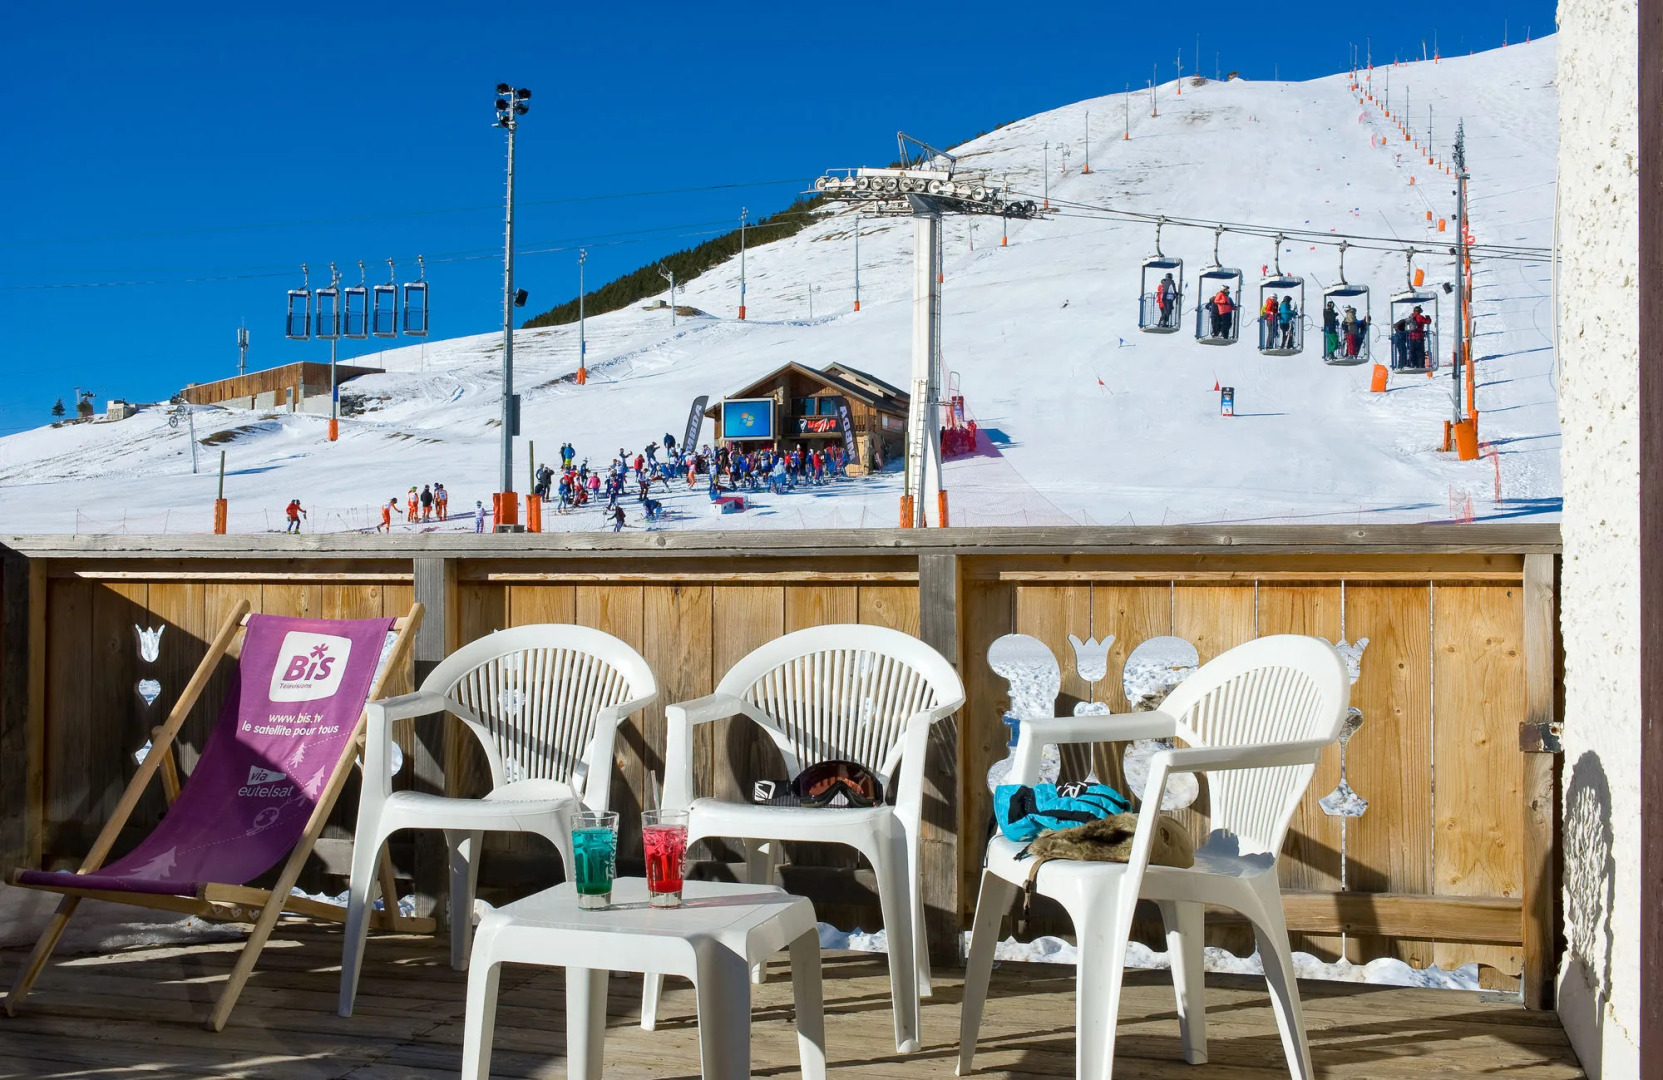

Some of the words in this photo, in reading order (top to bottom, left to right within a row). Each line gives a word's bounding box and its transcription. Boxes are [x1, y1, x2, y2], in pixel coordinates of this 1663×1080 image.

[839, 405, 856, 461] MBDA
[268, 712, 324, 724] www.bis.tv
[241, 720, 252, 732] le
[253, 725, 292, 736] satellite
[292, 727, 316, 738] pour
[318, 724, 340, 735] tous
[250, 769, 268, 781] via
[238, 784, 294, 798] eutelsat
